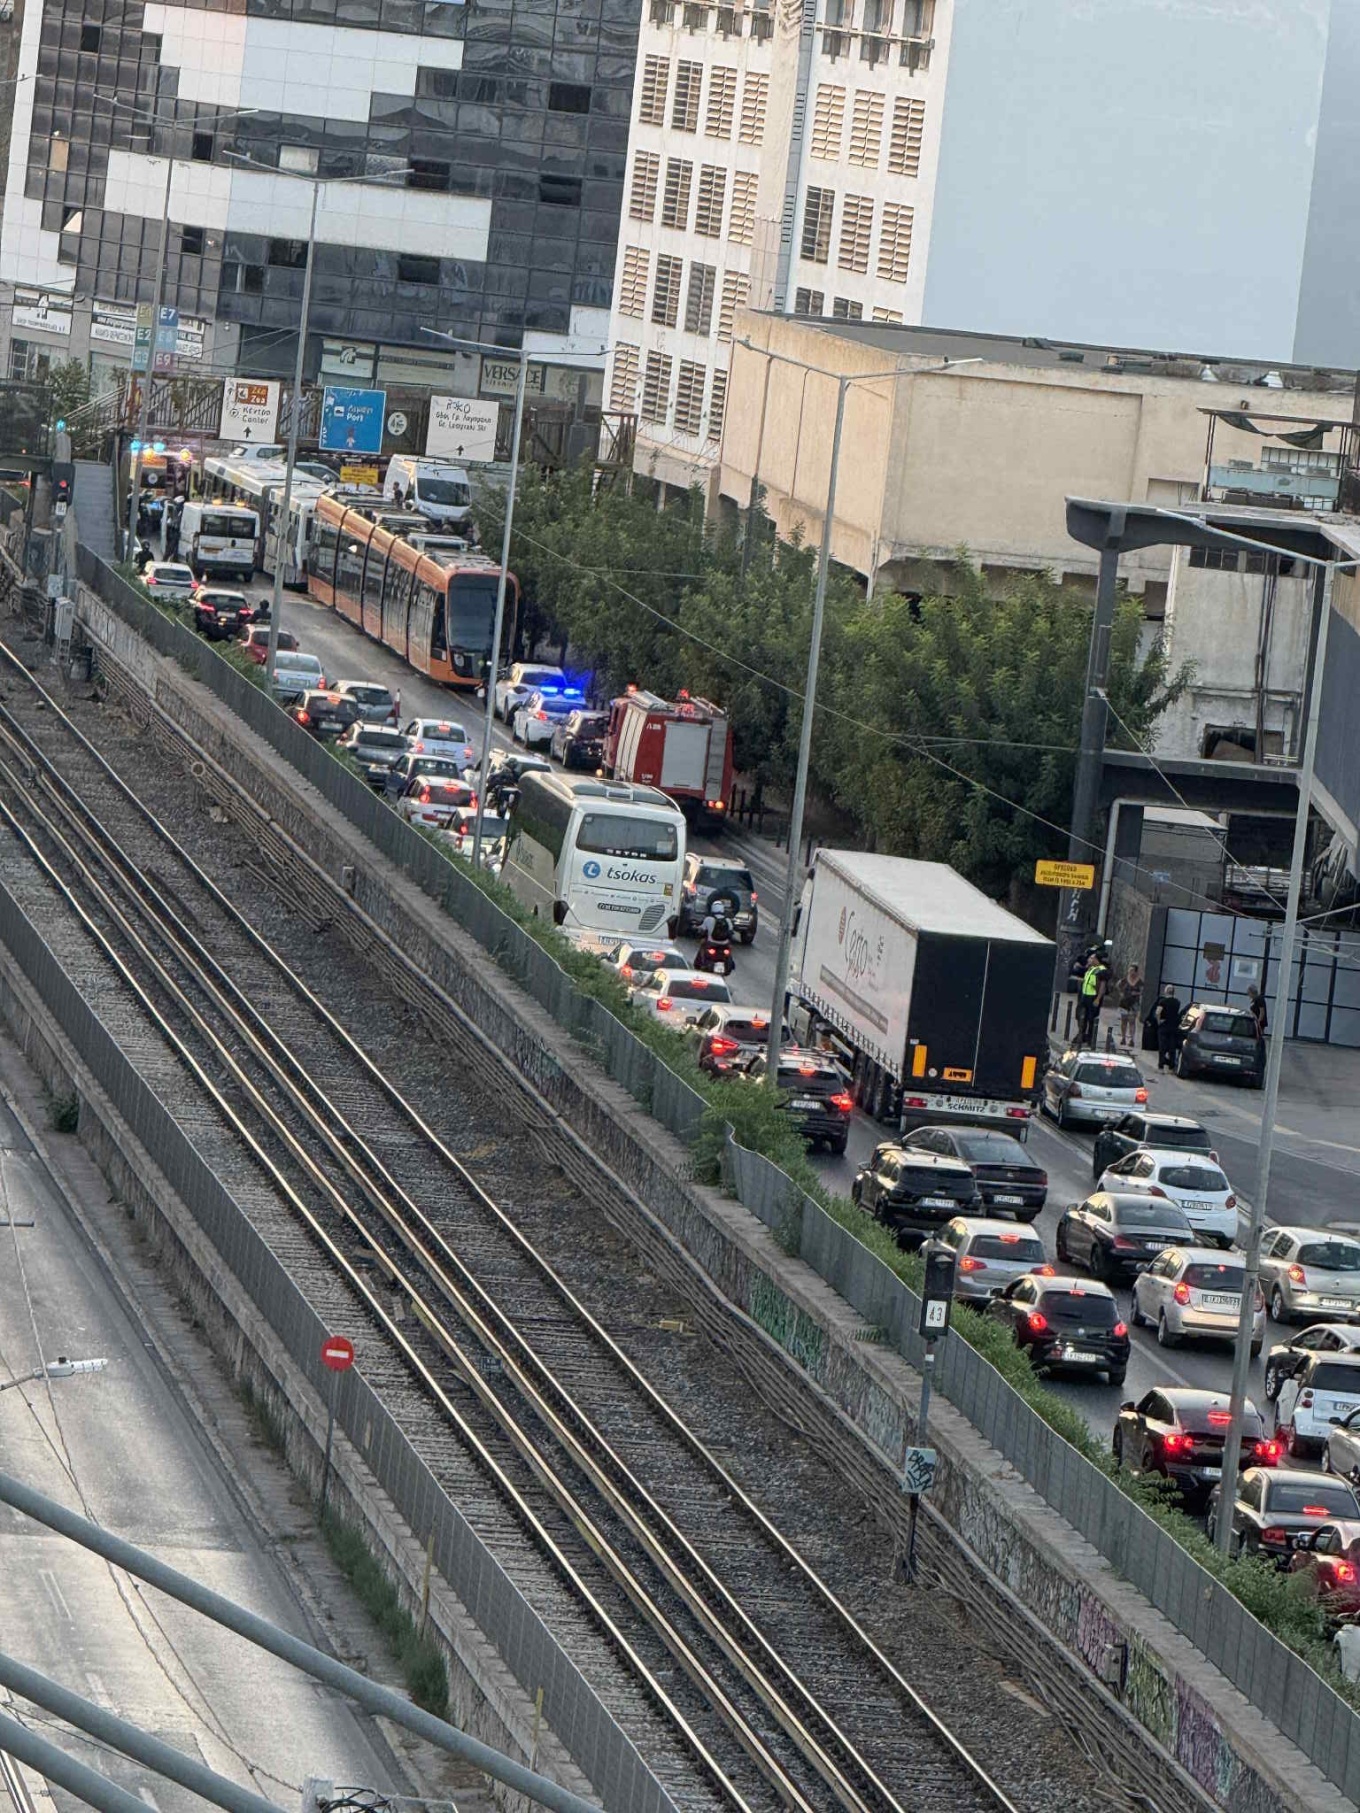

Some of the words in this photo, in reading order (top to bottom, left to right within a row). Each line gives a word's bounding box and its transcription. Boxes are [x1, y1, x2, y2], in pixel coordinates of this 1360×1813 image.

[160, 307, 176, 320] E7
[137, 328, 151, 340] E2
[155, 353, 171, 367] E9
[607, 866, 657, 884] tsokas
